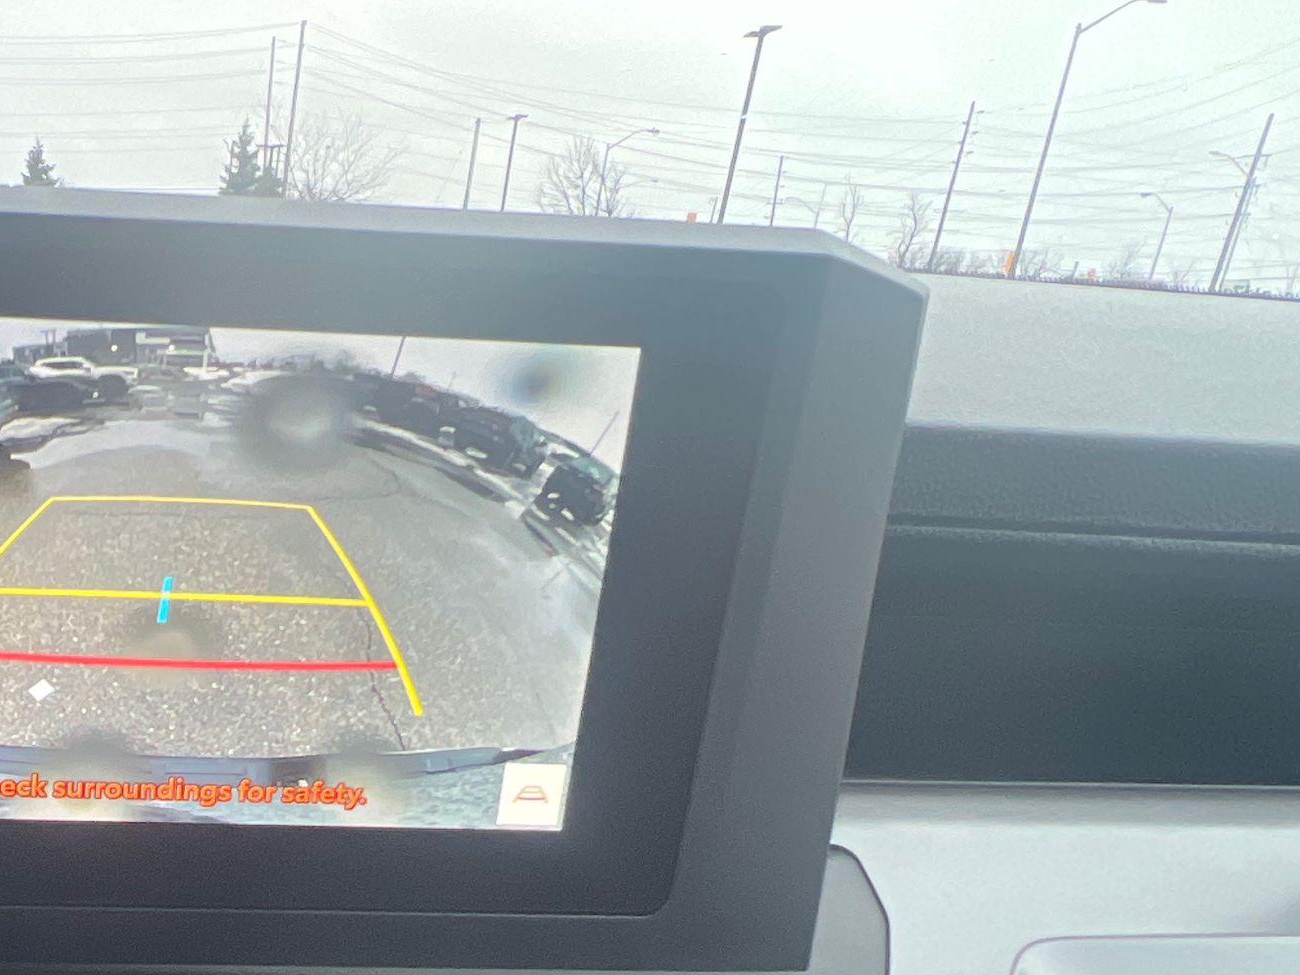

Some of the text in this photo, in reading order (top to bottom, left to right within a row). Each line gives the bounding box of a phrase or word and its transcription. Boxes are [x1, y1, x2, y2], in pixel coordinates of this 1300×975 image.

[52, 776, 232, 807] surroundings
[238, 777, 278, 803] for
[280, 780, 368, 810] safety.
